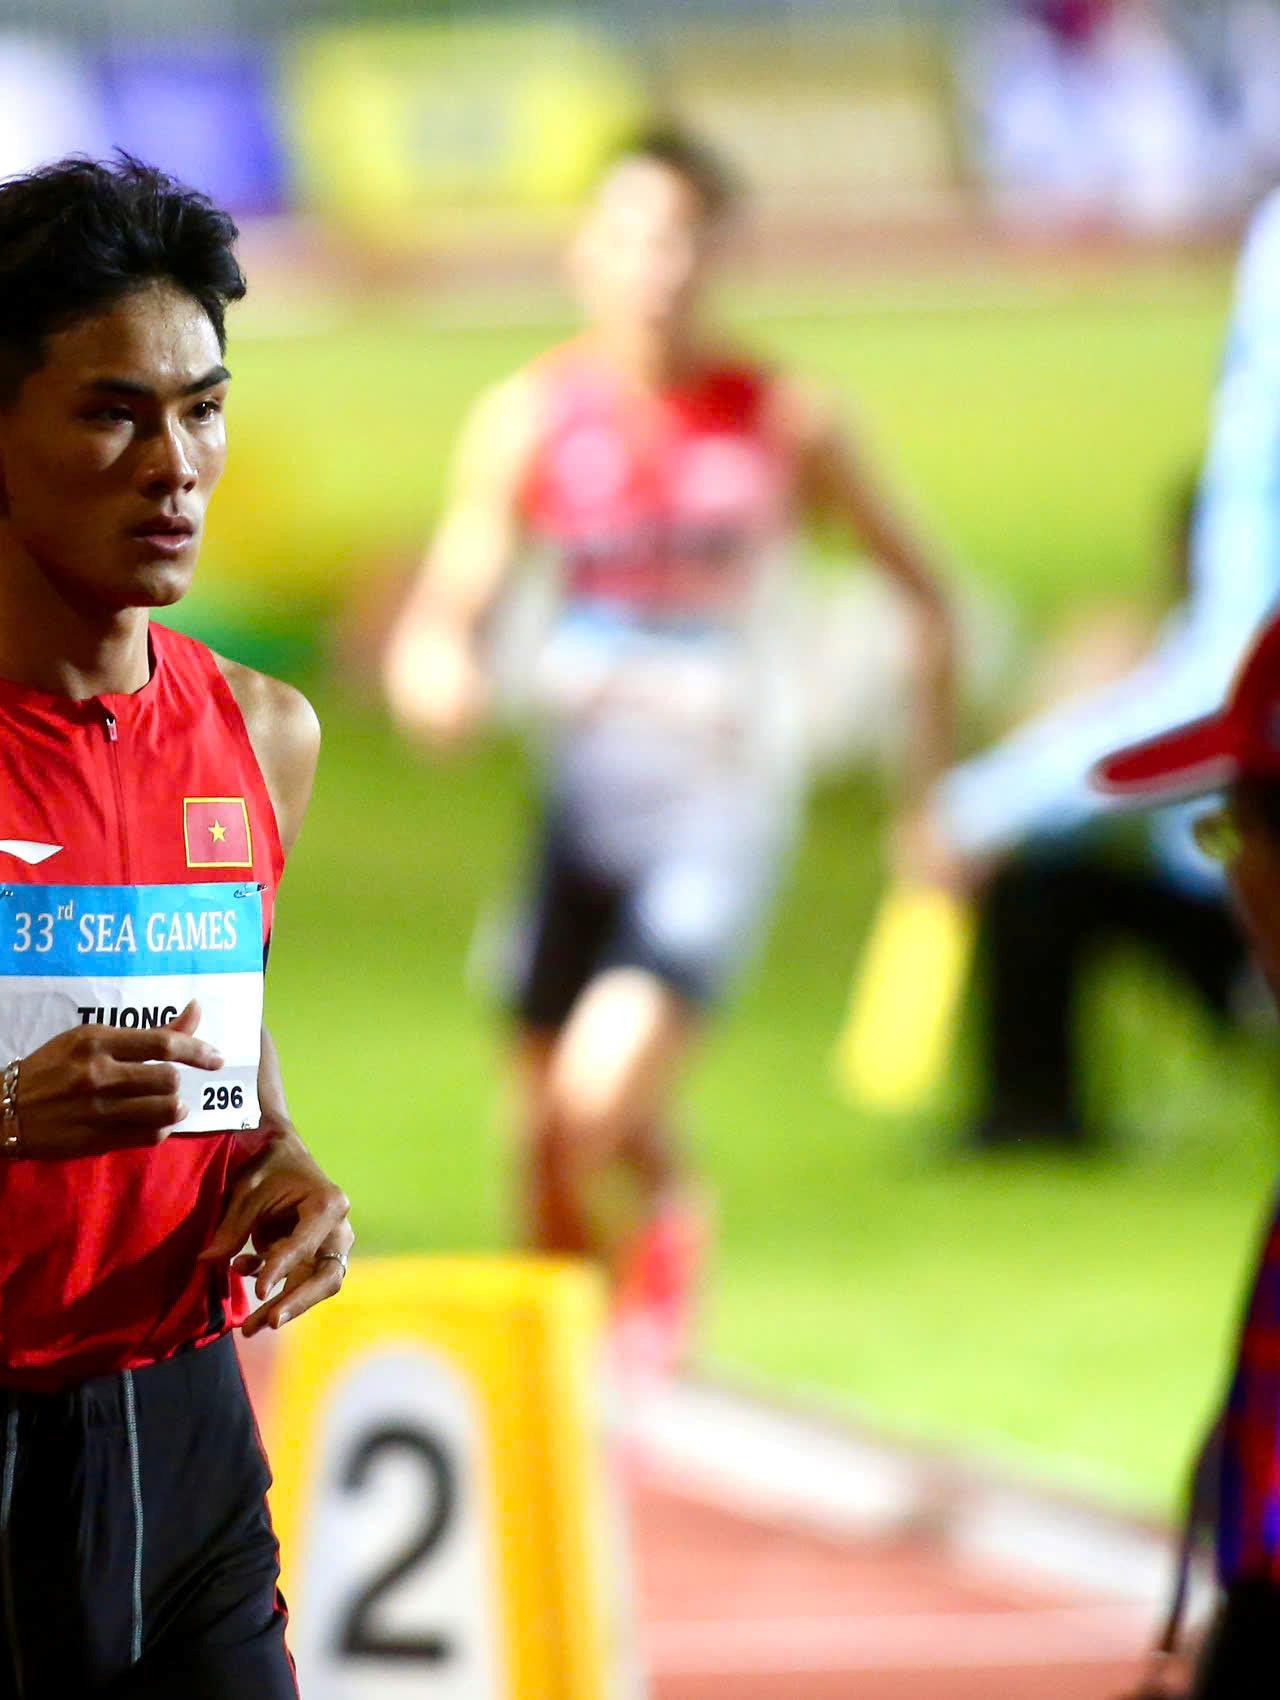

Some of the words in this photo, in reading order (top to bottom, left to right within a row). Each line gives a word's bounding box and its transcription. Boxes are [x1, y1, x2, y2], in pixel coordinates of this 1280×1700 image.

[77, 913, 137, 952] SEA
[146, 910, 237, 951] GAMES
[202, 1085, 244, 1111] 296
[332, 1417, 458, 1659] 2
